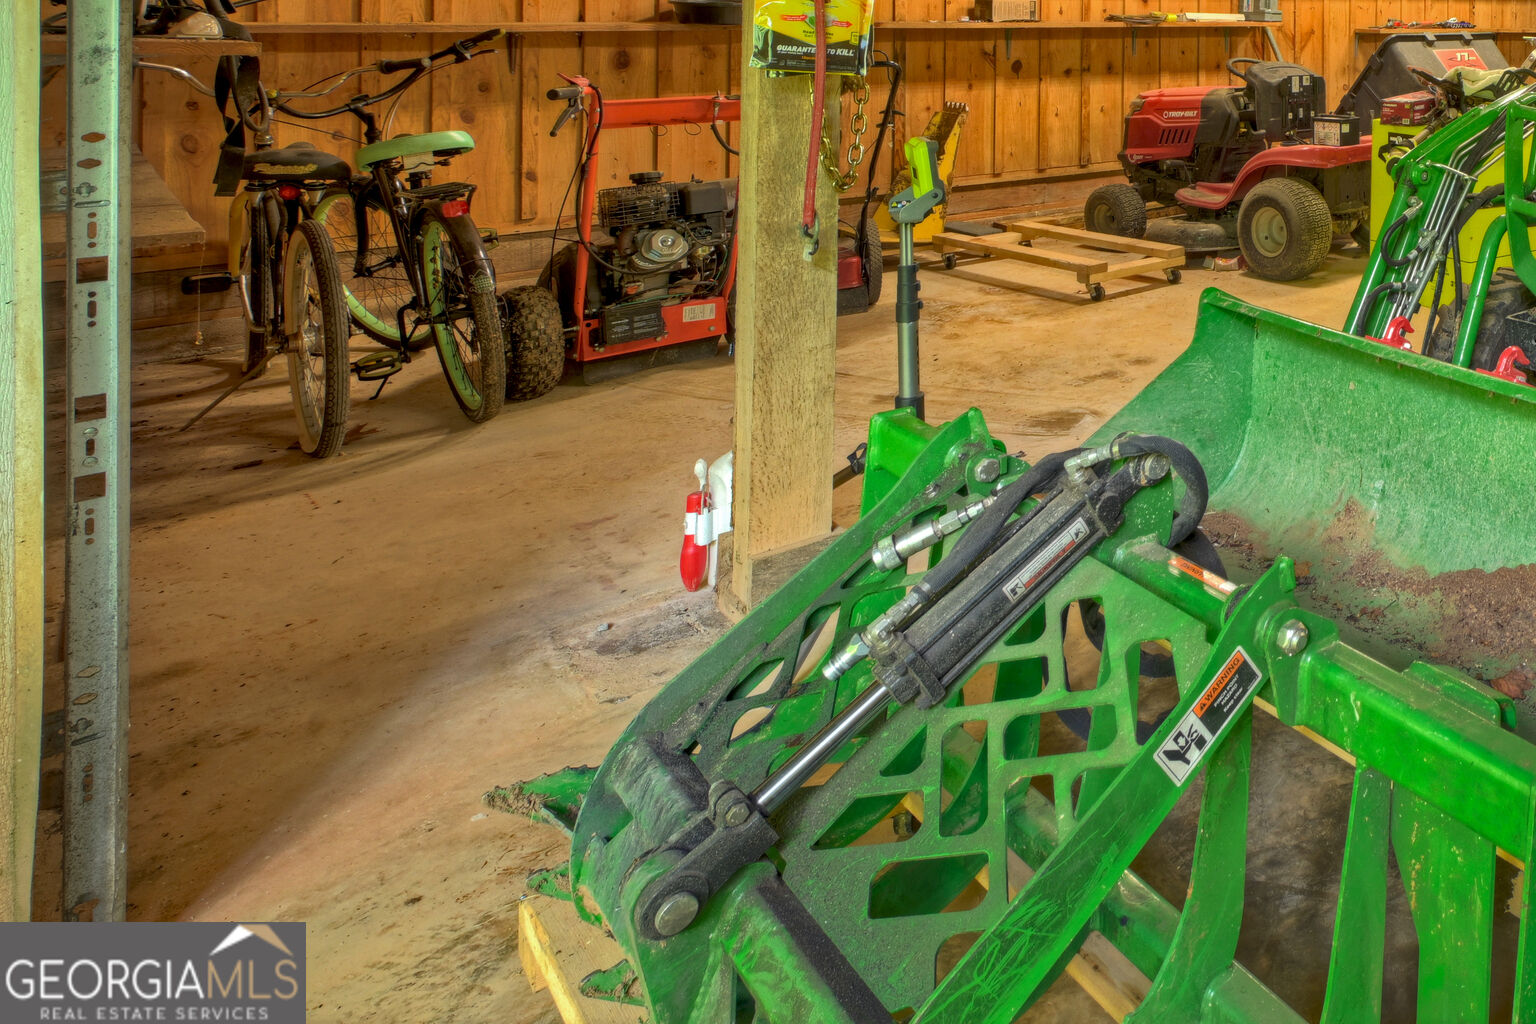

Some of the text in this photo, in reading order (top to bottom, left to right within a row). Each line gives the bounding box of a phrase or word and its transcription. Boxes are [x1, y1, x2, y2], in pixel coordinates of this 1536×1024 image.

[777, 45, 816, 54] GUARANTE
[1207, 656, 1241, 704] WARNING
[1226, 674, 1239, 690] POINT
